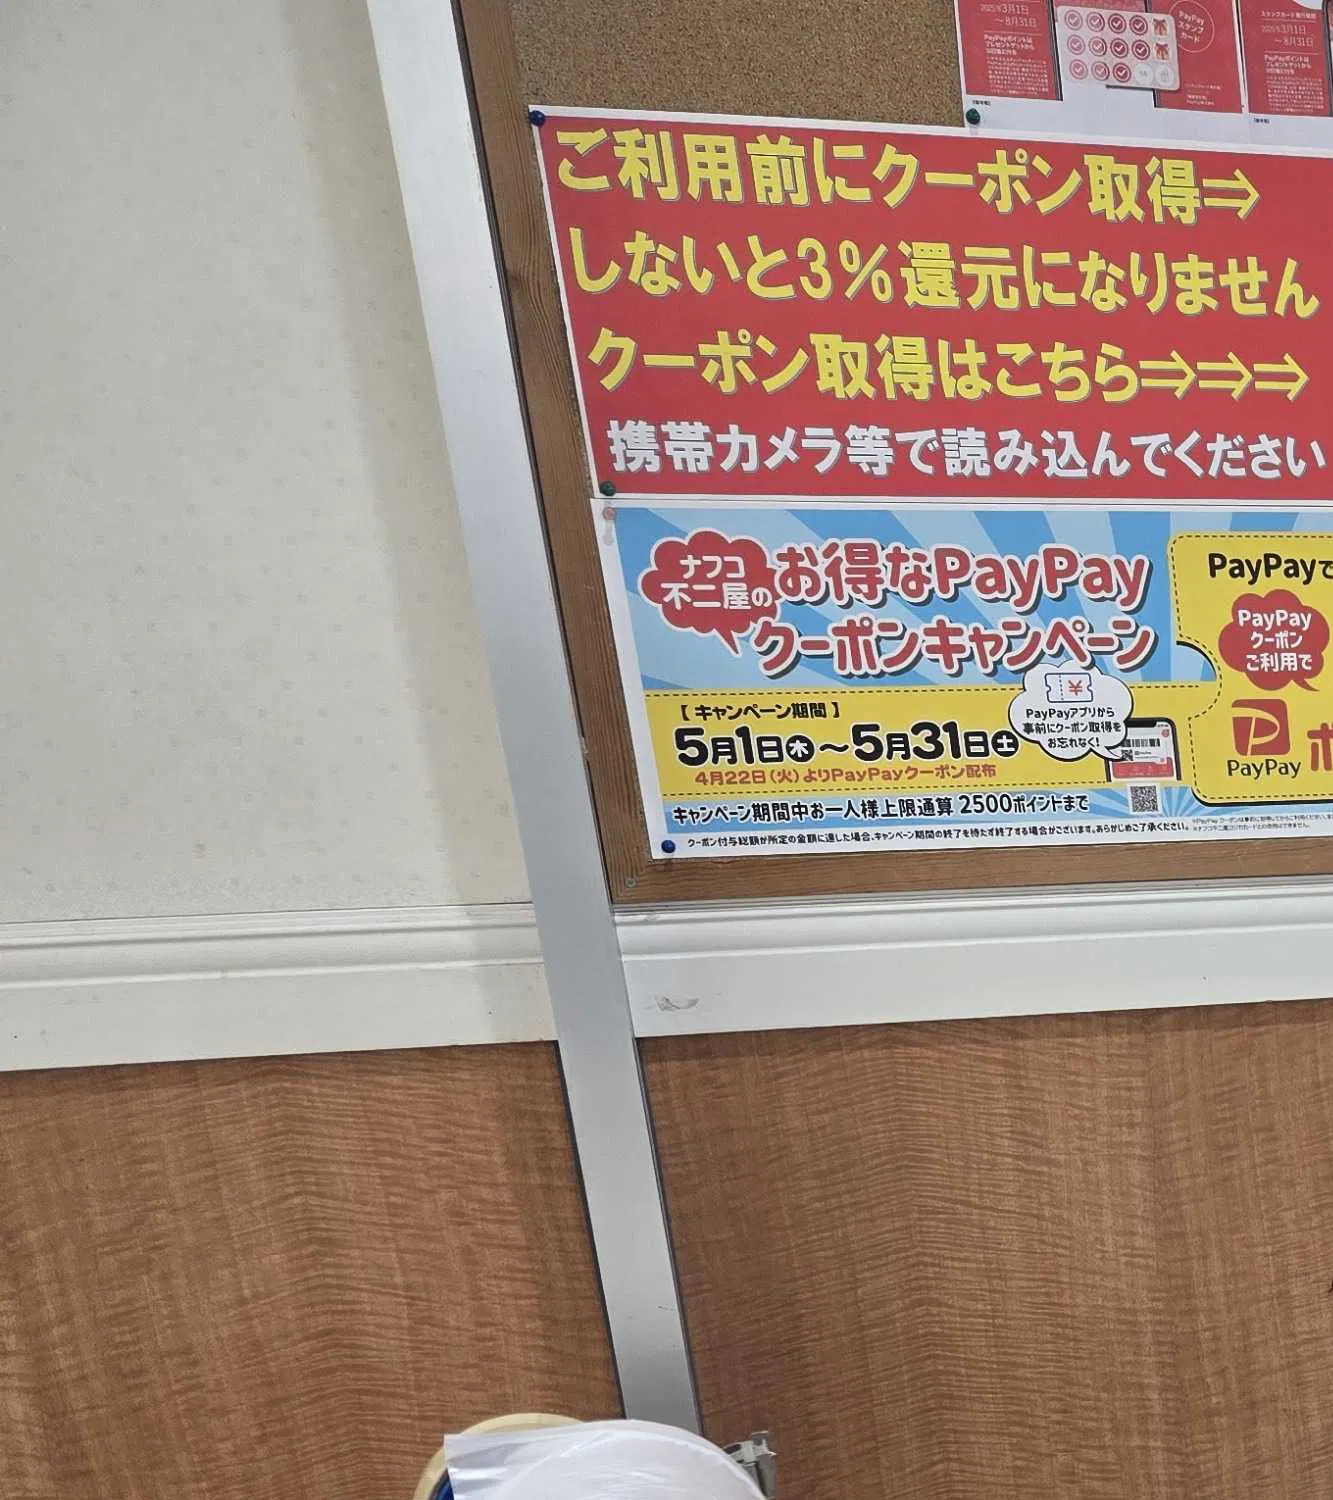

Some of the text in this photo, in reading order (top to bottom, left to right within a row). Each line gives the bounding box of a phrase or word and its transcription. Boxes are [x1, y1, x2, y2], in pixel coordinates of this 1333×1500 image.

[606, 419, 1328, 480] 携帯カメラ等で読み込んでください
[680, 554, 746, 579] ナフコ
[775, 541, 1151, 610] お得なPayPay
[661, 581, 771, 611] 不二屋の
[1237, 609, 1312, 632] PayPay
[753, 617, 1153, 677] クーポンキャンペーン
[1251, 632, 1302, 649] クーポン
[1246, 652, 1313, 673] ご利用で
[1025, 706, 1115, 721] PayPayアプリから
[1023, 720, 1122, 736] 事前にクーポン取得を
[1227, 758, 1301, 779] PayPay
